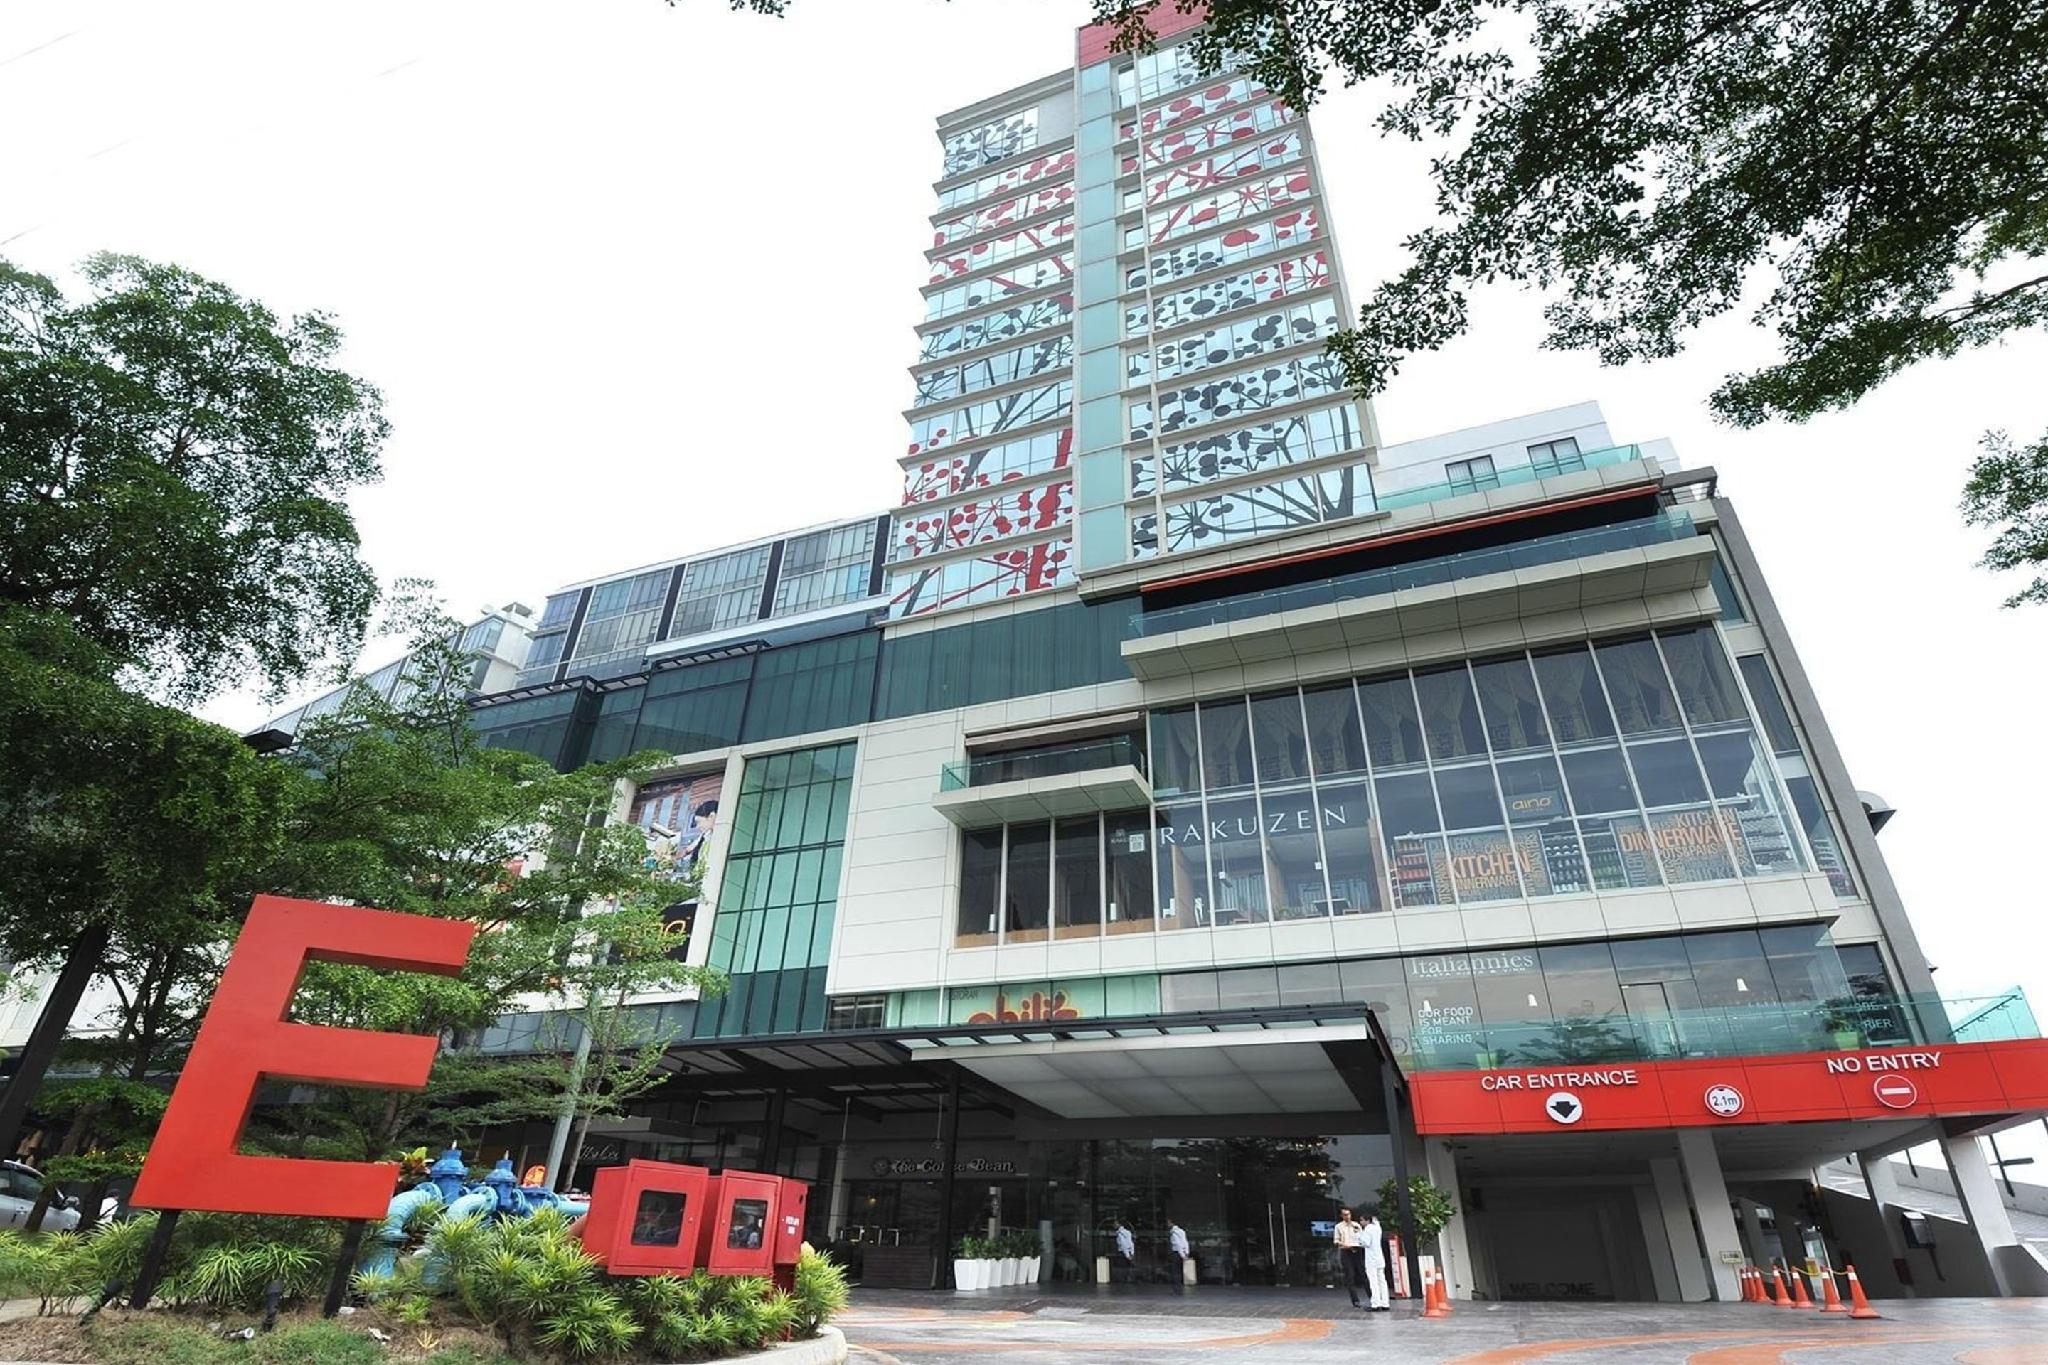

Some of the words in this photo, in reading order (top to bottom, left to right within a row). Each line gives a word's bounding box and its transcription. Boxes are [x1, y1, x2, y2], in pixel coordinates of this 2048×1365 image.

[1160, 805, 1348, 845] RAKUZEN
[1661, 843, 1718, 860] OTS&PANS
[1453, 874, 1520, 891] INNERWARE
[1411, 953, 1534, 974] Italiannies
[1443, 1006, 1474, 1017] FOOD
[1419, 1018, 1430, 1026] IS
[1432, 1016, 1472, 1026] MEANT
[1421, 1027, 1443, 1035] FOR
[1422, 1033, 1473, 1045] SHARING
[131, 893, 474, 1220] E
[1827, 1057, 1861, 1074] NO
[1866, 1051, 1942, 1072] ENTRY
[1481, 1074, 1522, 1090] CAR
[1526, 1069, 1639, 1089] ENTRANCE
[1711, 1095, 1738, 1107] 2.1m
[917, 1158, 966, 1173] Cofee
[970, 1157, 1016, 1174] Bean
